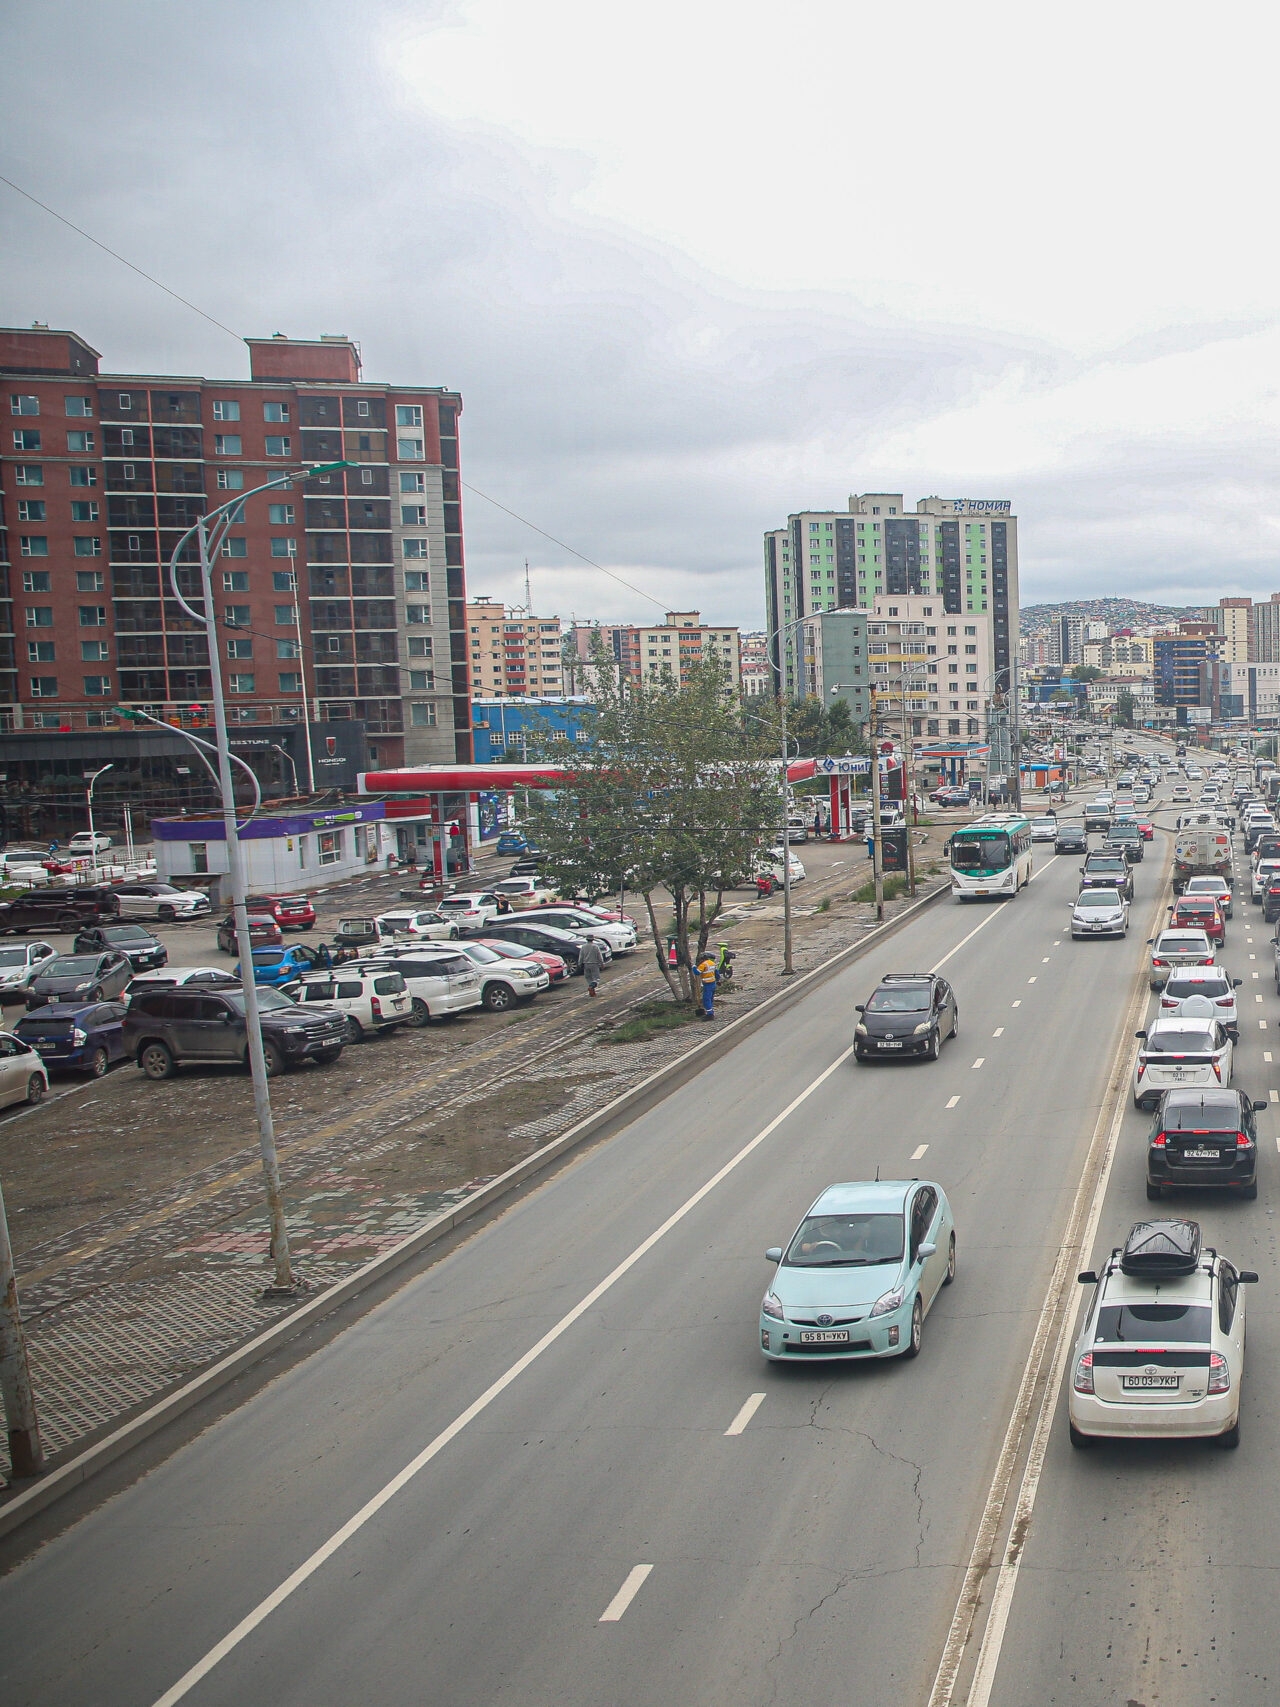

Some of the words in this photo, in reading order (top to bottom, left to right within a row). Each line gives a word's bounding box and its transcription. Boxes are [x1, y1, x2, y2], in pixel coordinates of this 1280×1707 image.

[968, 500, 1010, 510] НОМИН
[839, 762, 884, 772] ЮниГз
[1159, 1376, 1176, 1385] УКР
